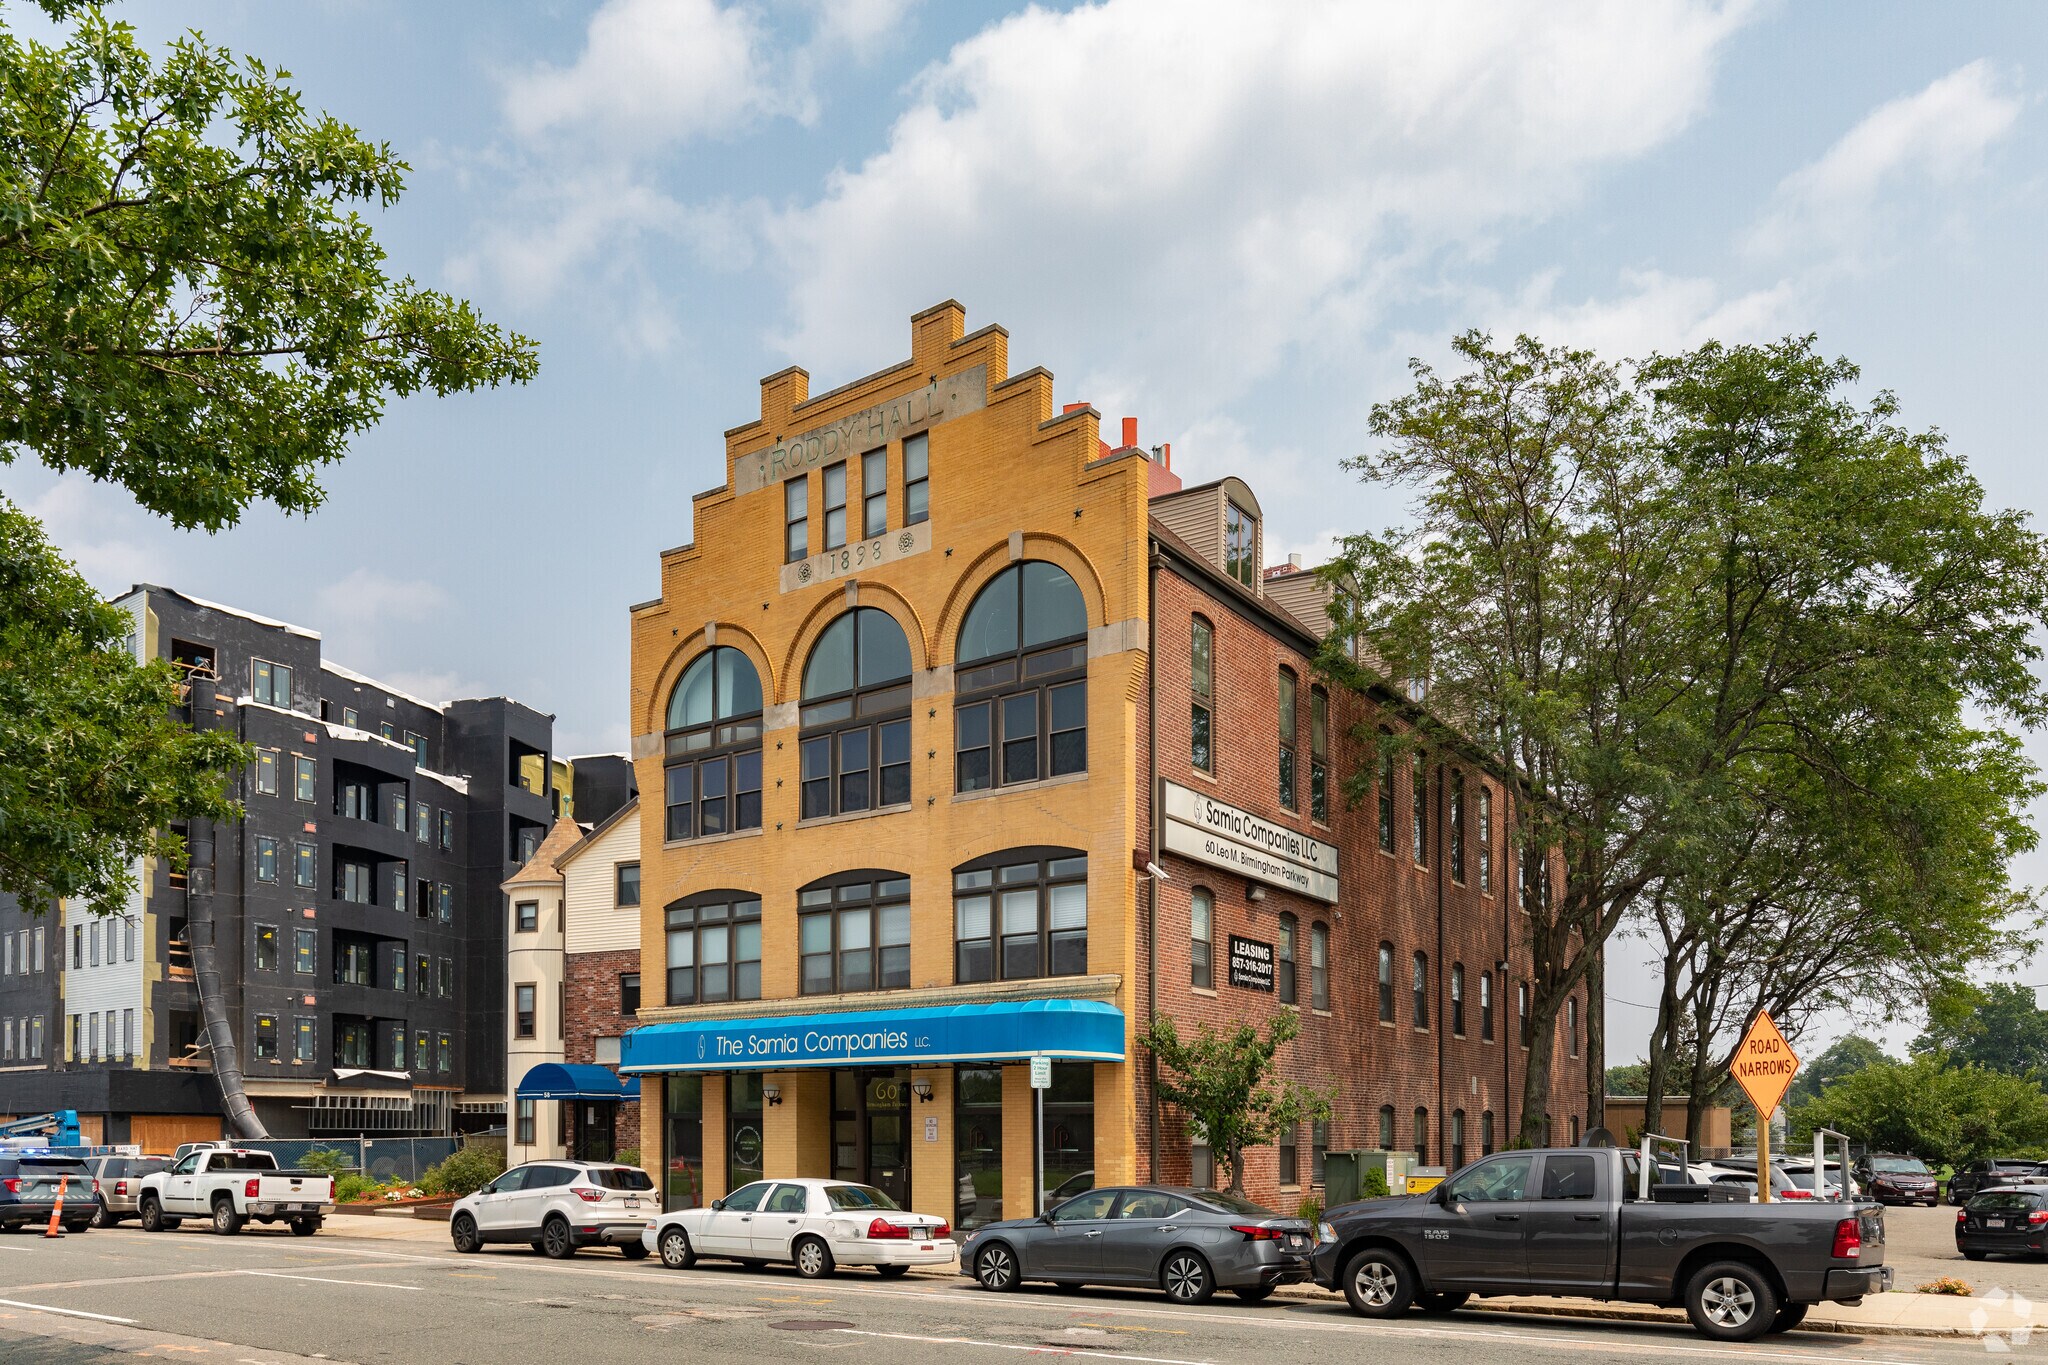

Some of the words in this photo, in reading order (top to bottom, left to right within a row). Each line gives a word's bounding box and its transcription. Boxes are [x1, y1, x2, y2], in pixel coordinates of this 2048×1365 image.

[770, 420, 858, 480] RODDY
[866, 392, 943, 444] HALL
[830, 540, 882, 575] 1898
[1206, 800, 1241, 834] Samia
[1243, 815, 1300, 856] Companies
[1301, 838, 1318, 862] LLC
[1205, 840, 1215, 855] 60
[1216, 843, 1229, 859] Leo
[1230, 848, 1239, 863] M.
[1240, 852, 1281, 876] Birmingham
[1281, 866, 1310, 889] Parkway
[1234, 940, 1270, 961] LEASING
[1232, 956, 1272, 975] 857-316-2017
[716, 1036, 743, 1056] The
[748, 1033, 798, 1055] Samia
[804, 1028, 908, 1058] Companies
[1750, 1038, 1779, 1054] ROAD
[1739, 1059, 1791, 1077] NARROWS
[876, 1081, 897, 1100] 60
